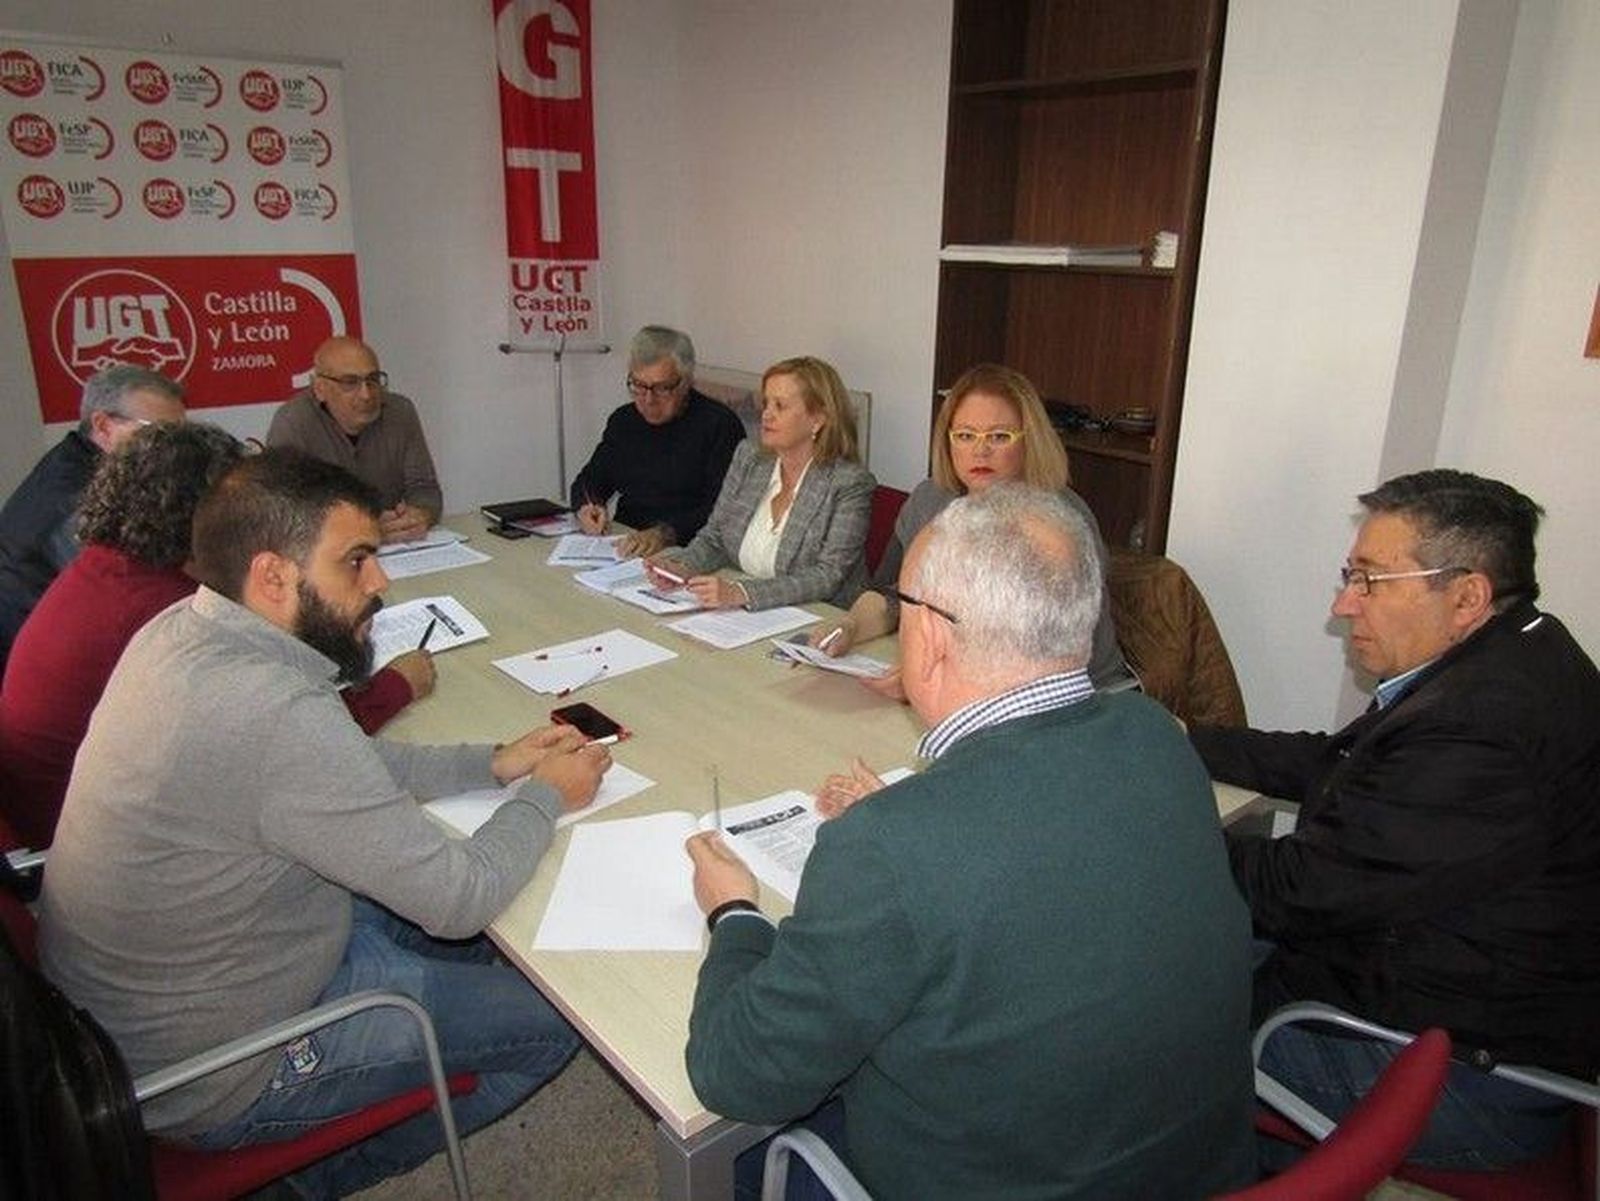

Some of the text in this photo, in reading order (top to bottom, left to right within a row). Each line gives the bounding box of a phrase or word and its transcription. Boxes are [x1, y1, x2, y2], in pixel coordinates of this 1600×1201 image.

[48, 61, 83, 76] FICA
[180, 127, 209, 142] FICA
[68, 180, 95, 194] UJP
[204, 291, 297, 315] Castilla
[513, 294, 591, 315] Castilla
[73, 295, 171, 344] UGT
[521, 312, 588, 334] y León
[208, 319, 290, 349] y León
[212, 354, 277, 371] ZAMORA
